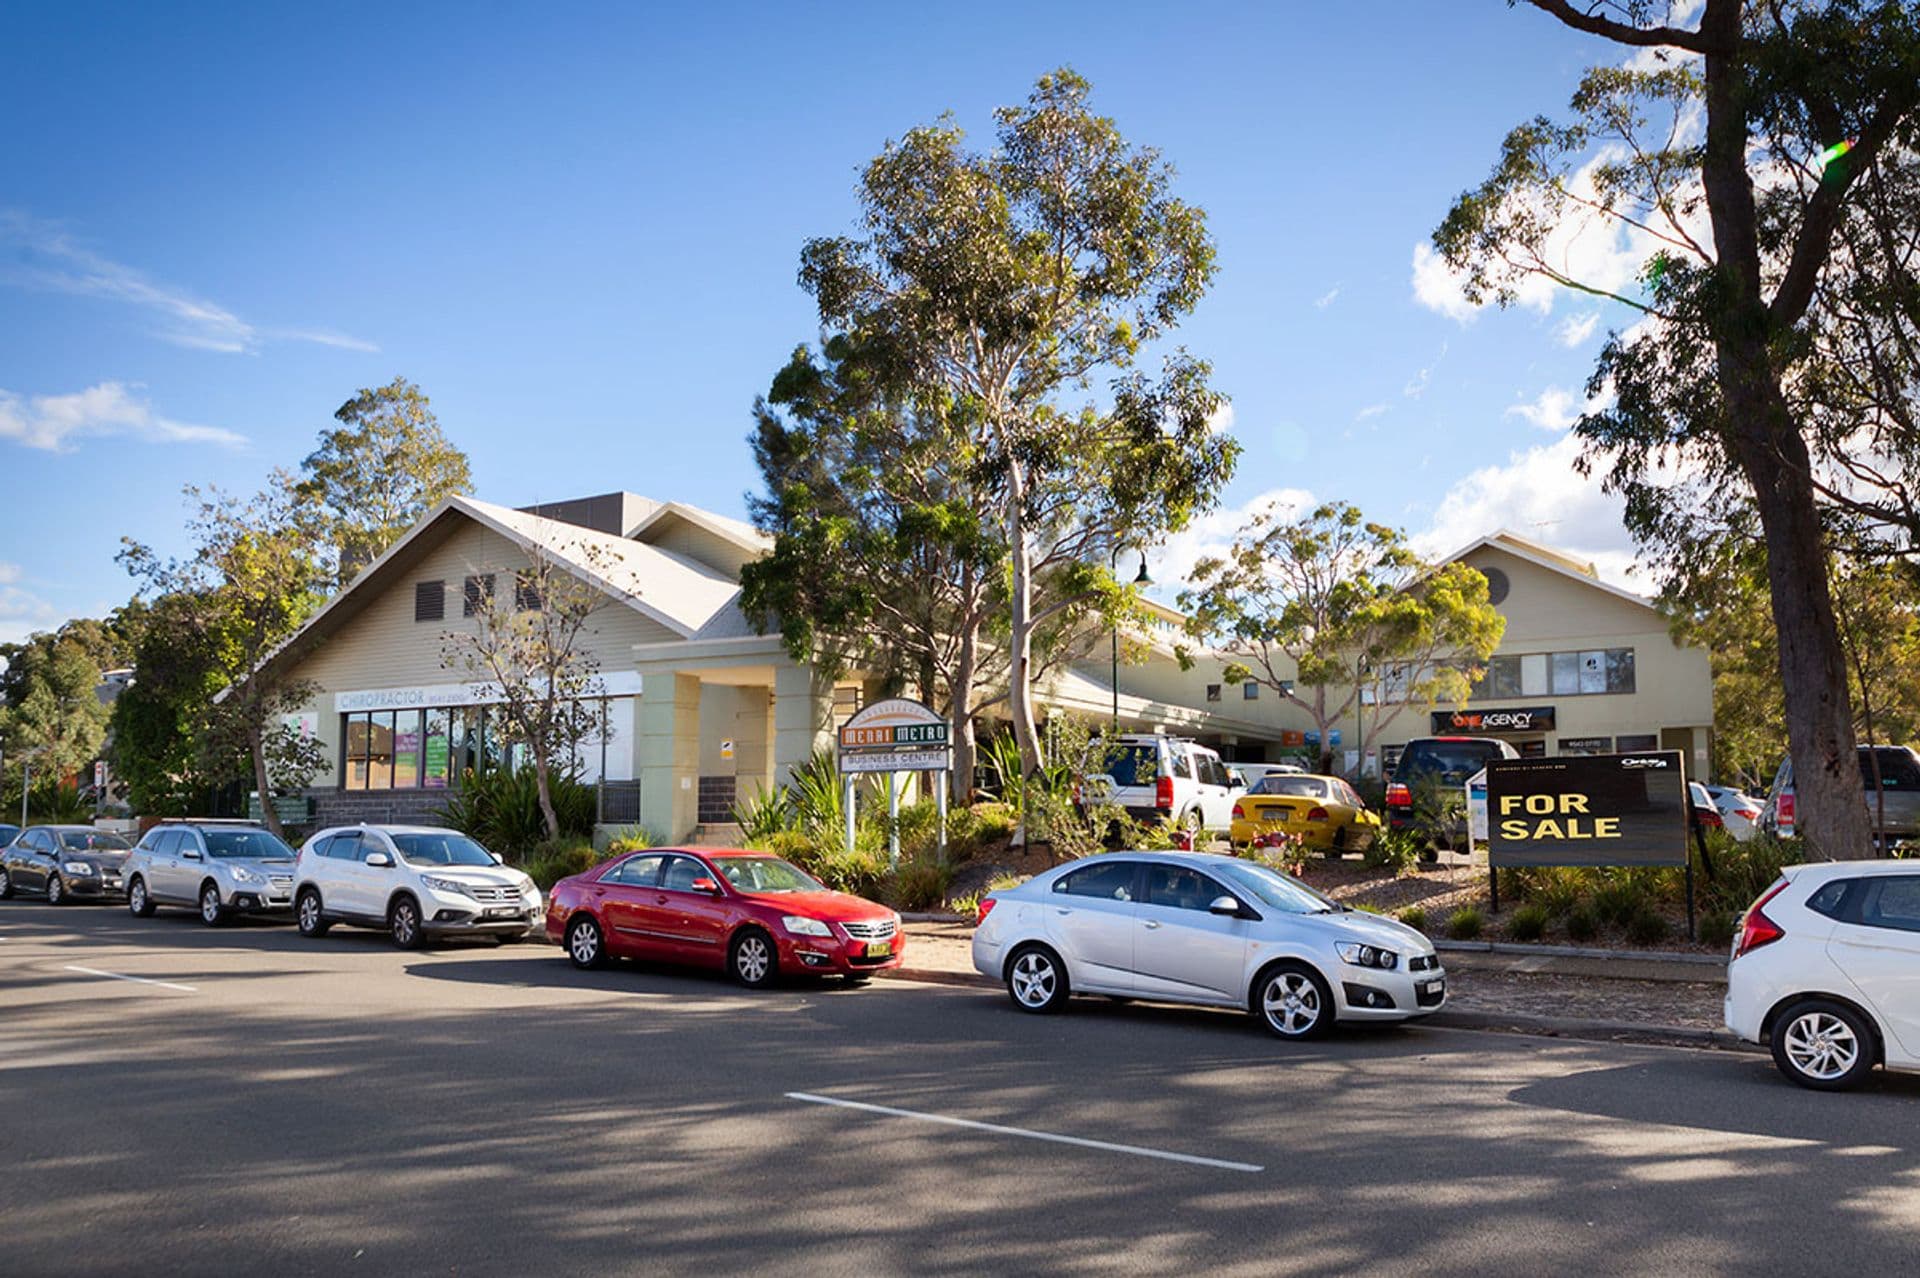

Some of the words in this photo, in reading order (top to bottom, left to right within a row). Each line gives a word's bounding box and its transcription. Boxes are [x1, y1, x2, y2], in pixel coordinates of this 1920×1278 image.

[340, 690, 425, 708] CHIROPRACTOR
[1452, 714, 1482, 728] ONE
[1482, 712, 1532, 726] AGENCY
[845, 728, 890, 744] MENAI
[897, 725, 945, 741] METRO
[848, 754, 897, 764] BUSINESS
[900, 752, 942, 762] CENTRE
[1500, 793, 1590, 816] FOR
[1500, 817, 1622, 840] SALE
